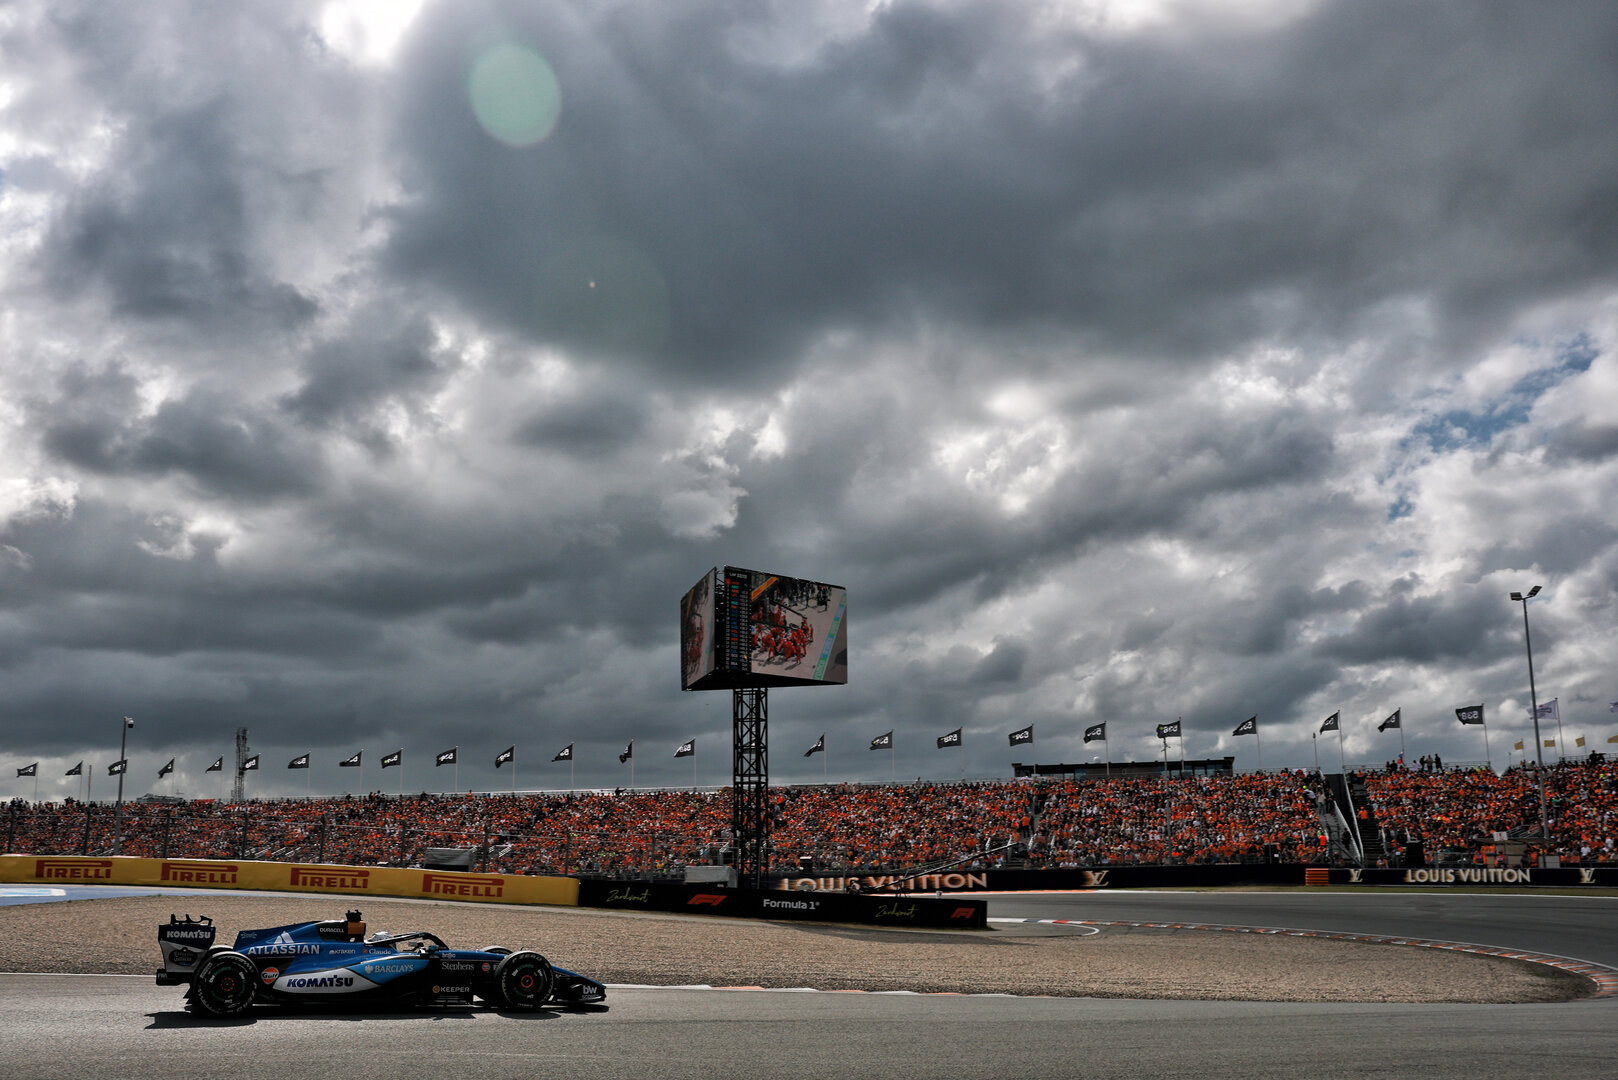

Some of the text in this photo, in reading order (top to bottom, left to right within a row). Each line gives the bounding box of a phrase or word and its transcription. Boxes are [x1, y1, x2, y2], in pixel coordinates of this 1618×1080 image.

[36, 860, 112, 878] PIRELLI
[161, 862, 238, 884] PIRELLI
[1407, 868, 1531, 882] LOUIS VUITTON
[290, 868, 370, 888] PIRELLI
[866, 872, 988, 890] VUITTON
[422, 874, 504, 897] PIRELLI
[763, 899, 807, 910] Formula
[166, 929, 212, 939] KOMATSU
[248, 944, 320, 955] ATLASSIAN
[374, 964, 414, 973] BARCLAYS
[442, 962, 474, 971] Stephens
[262, 972, 278, 980] Gulf
[287, 974, 354, 988] KOMATSU
